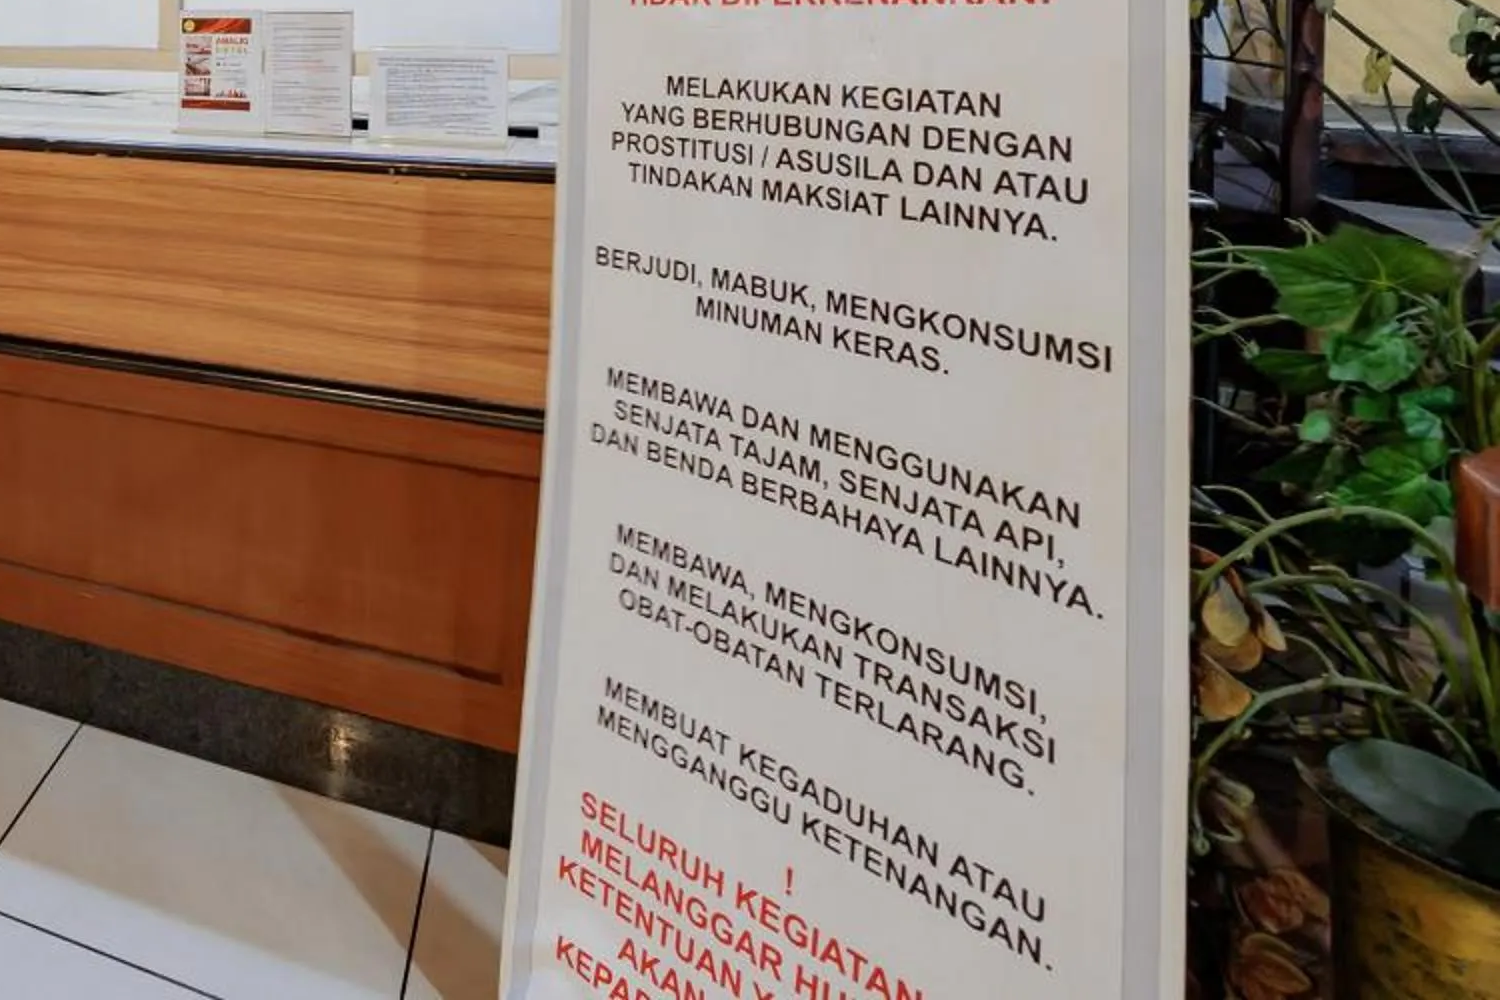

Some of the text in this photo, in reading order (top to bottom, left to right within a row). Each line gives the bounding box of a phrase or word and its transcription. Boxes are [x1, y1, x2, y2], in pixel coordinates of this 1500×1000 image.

[612, 131, 753, 166] PROSTITUSI
[775, 147, 903, 184] ASUSILA
[913, 160, 982, 192] DAN
[992, 170, 1088, 205] ATAU
[621, 102, 1072, 163] YANG BERHUBUNGAN DENGAN
[666, 75, 1001, 118] MELAKUKAN KEGIATAN
[628, 160, 1057, 242] TINDAKAN MAKSIAT LAINNYA.
[596, 246, 1112, 373] BERJUDI, MABUK, MENGKONSUMSI
[696, 296, 948, 375] MINUMAN KERAS.
[591, 422, 1103, 619] DAN BENDA BERBAHAYA LAINNYA.
[607, 367, 1080, 529] MEMBAWA DAN MENGGUNAKAN
[614, 399, 1065, 569] SENJATA TAJAM, SENJATA API,
[610, 552, 1055, 765] DAN MELAKUKAN TRANSAKSI
[617, 524, 1046, 725] MEMBAWA, MENGKONSUMSI,
[619, 588, 1034, 796] OBAT-OBATAN TERLARANG.
[581, 792, 724, 898] SELURUH
[598, 704, 1052, 971] MENGGANGGU KETENANGAN.
[605, 676, 1045, 923] MEMBUAT KEGADUHAN ATAU
[559, 855, 742, 998] KETENTUAN
[581, 829, 783, 982] MELANGGAR
